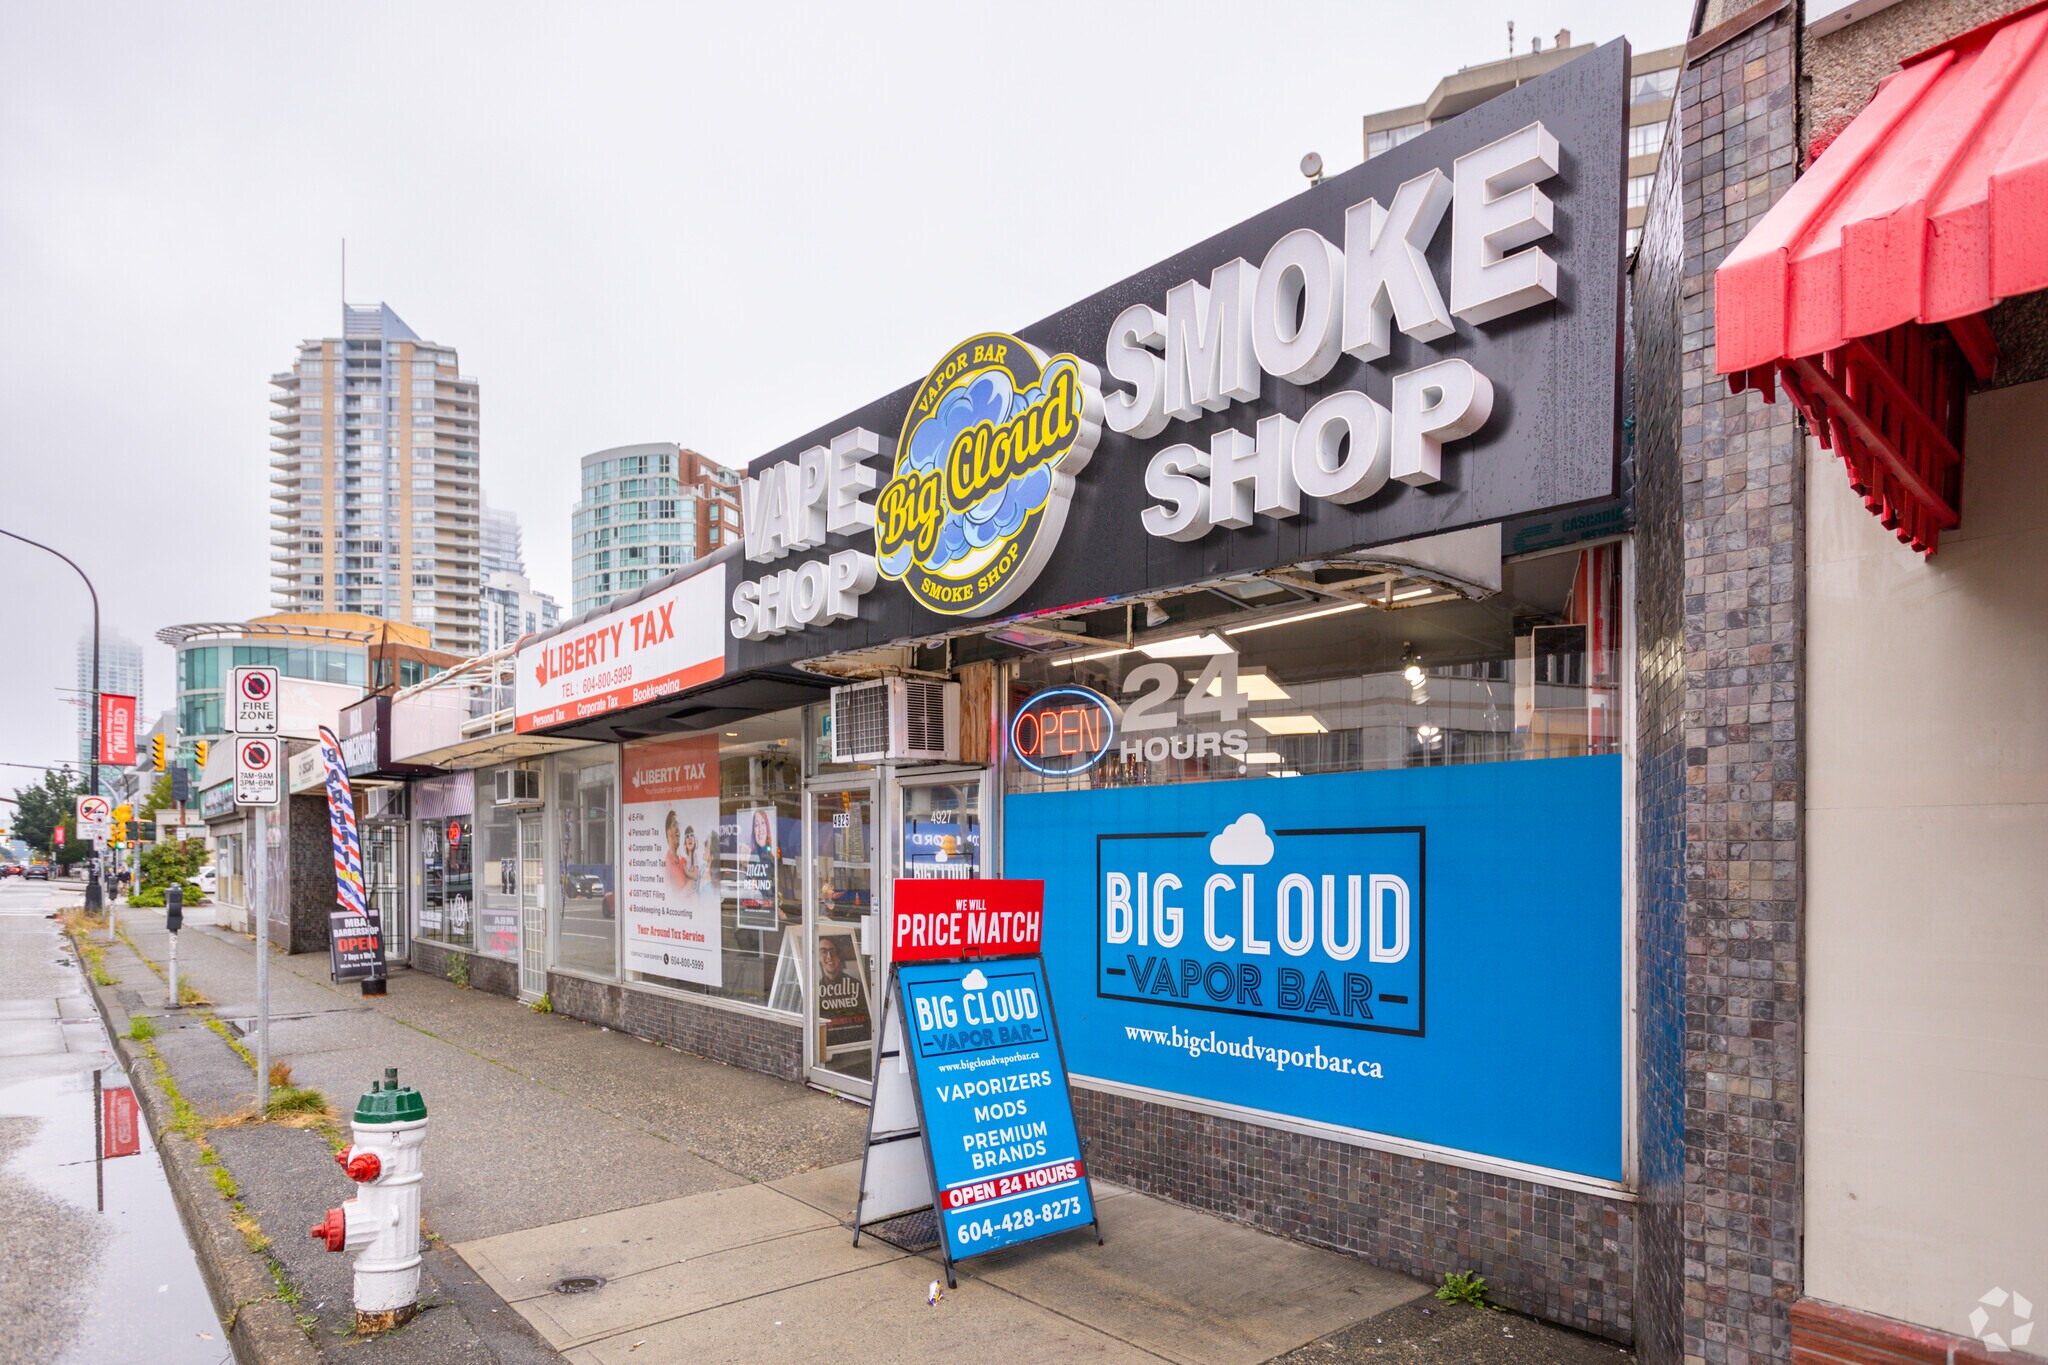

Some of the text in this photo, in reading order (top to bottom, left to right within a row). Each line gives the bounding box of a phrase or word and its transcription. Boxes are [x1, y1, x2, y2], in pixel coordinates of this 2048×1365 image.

[1104, 120, 1560, 440] SMOKE
[919, 343, 1007, 412] VAPOR BAR
[1141, 358, 1494, 542] SHOP
[882, 374, 1074, 552] Big Cloud
[741, 427, 877, 563] VAPE
[921, 542, 1019, 603] SMOKE SHOP
[730, 549, 877, 641] SHOP
[549, 601, 675, 680] LIBERTY TAX
[583, 664, 633, 694] 604-800-5999
[532, 678, 680, 727] Personal Tax Corporate Tax Bookkeeping
[1121, 651, 1248, 732] 24
[240, 711, 274, 719] ZONE
[243, 702, 270, 710] FIRE
[1016, 707, 1100, 755] OPEN
[1121, 729, 1249, 764] HOURS
[640, 762, 706, 785] LIBERTY TAX
[632, 813, 644, 822] E-File
[833, 814, 849, 827] 4925
[931, 810, 952, 824] 4927
[632, 828, 659, 836] Personal Tax
[632, 844, 653, 852] Corporate
[633, 859, 658, 867] Estate/Trust
[746, 863, 768, 877] max
[633, 874, 664, 883] US Income Tax
[744, 879, 771, 891] REFUND
[633, 889, 665, 901] GST/HST Filing
[956, 899, 986, 911] WE WILL
[344, 917, 367, 928] MBA
[633, 904, 693, 919] Bookkeeping & Accounting
[1106, 871, 1410, 963] BIG CLOUD
[333, 926, 379, 937] BARBERSHOP
[637, 924, 705, 943] Year Around Tax Service
[897, 911, 1040, 948] PRICE MATCH
[338, 936, 379, 952] OPEN
[343, 953, 347, 961] 7
[348, 953, 360, 961] Days
[671, 956, 704, 970] 604-800-5999
[819, 977, 859, 999] ocally
[1126, 954, 1374, 1020] VAPOR BAR
[821, 998, 858, 1010] OWNED
[915, 987, 1038, 1031] BIG CLOUD
[932, 1023, 1033, 1051] VAPOR BAR
[938, 1051, 1040, 1073] www.bigcloudvaporbar.ca
[1125, 1025, 1384, 1079] www.bigcloudvaporbar.ca
[936, 1070, 1051, 1103] VAPORIZERS
[974, 1099, 1027, 1123] MODS
[962, 1120, 1047, 1152] PREMIUM
[971, 1140, 1046, 1170] BRANDS
[949, 1163, 1077, 1207] OPEN 24 HOURS
[957, 1196, 1081, 1244] 604-428-8273
